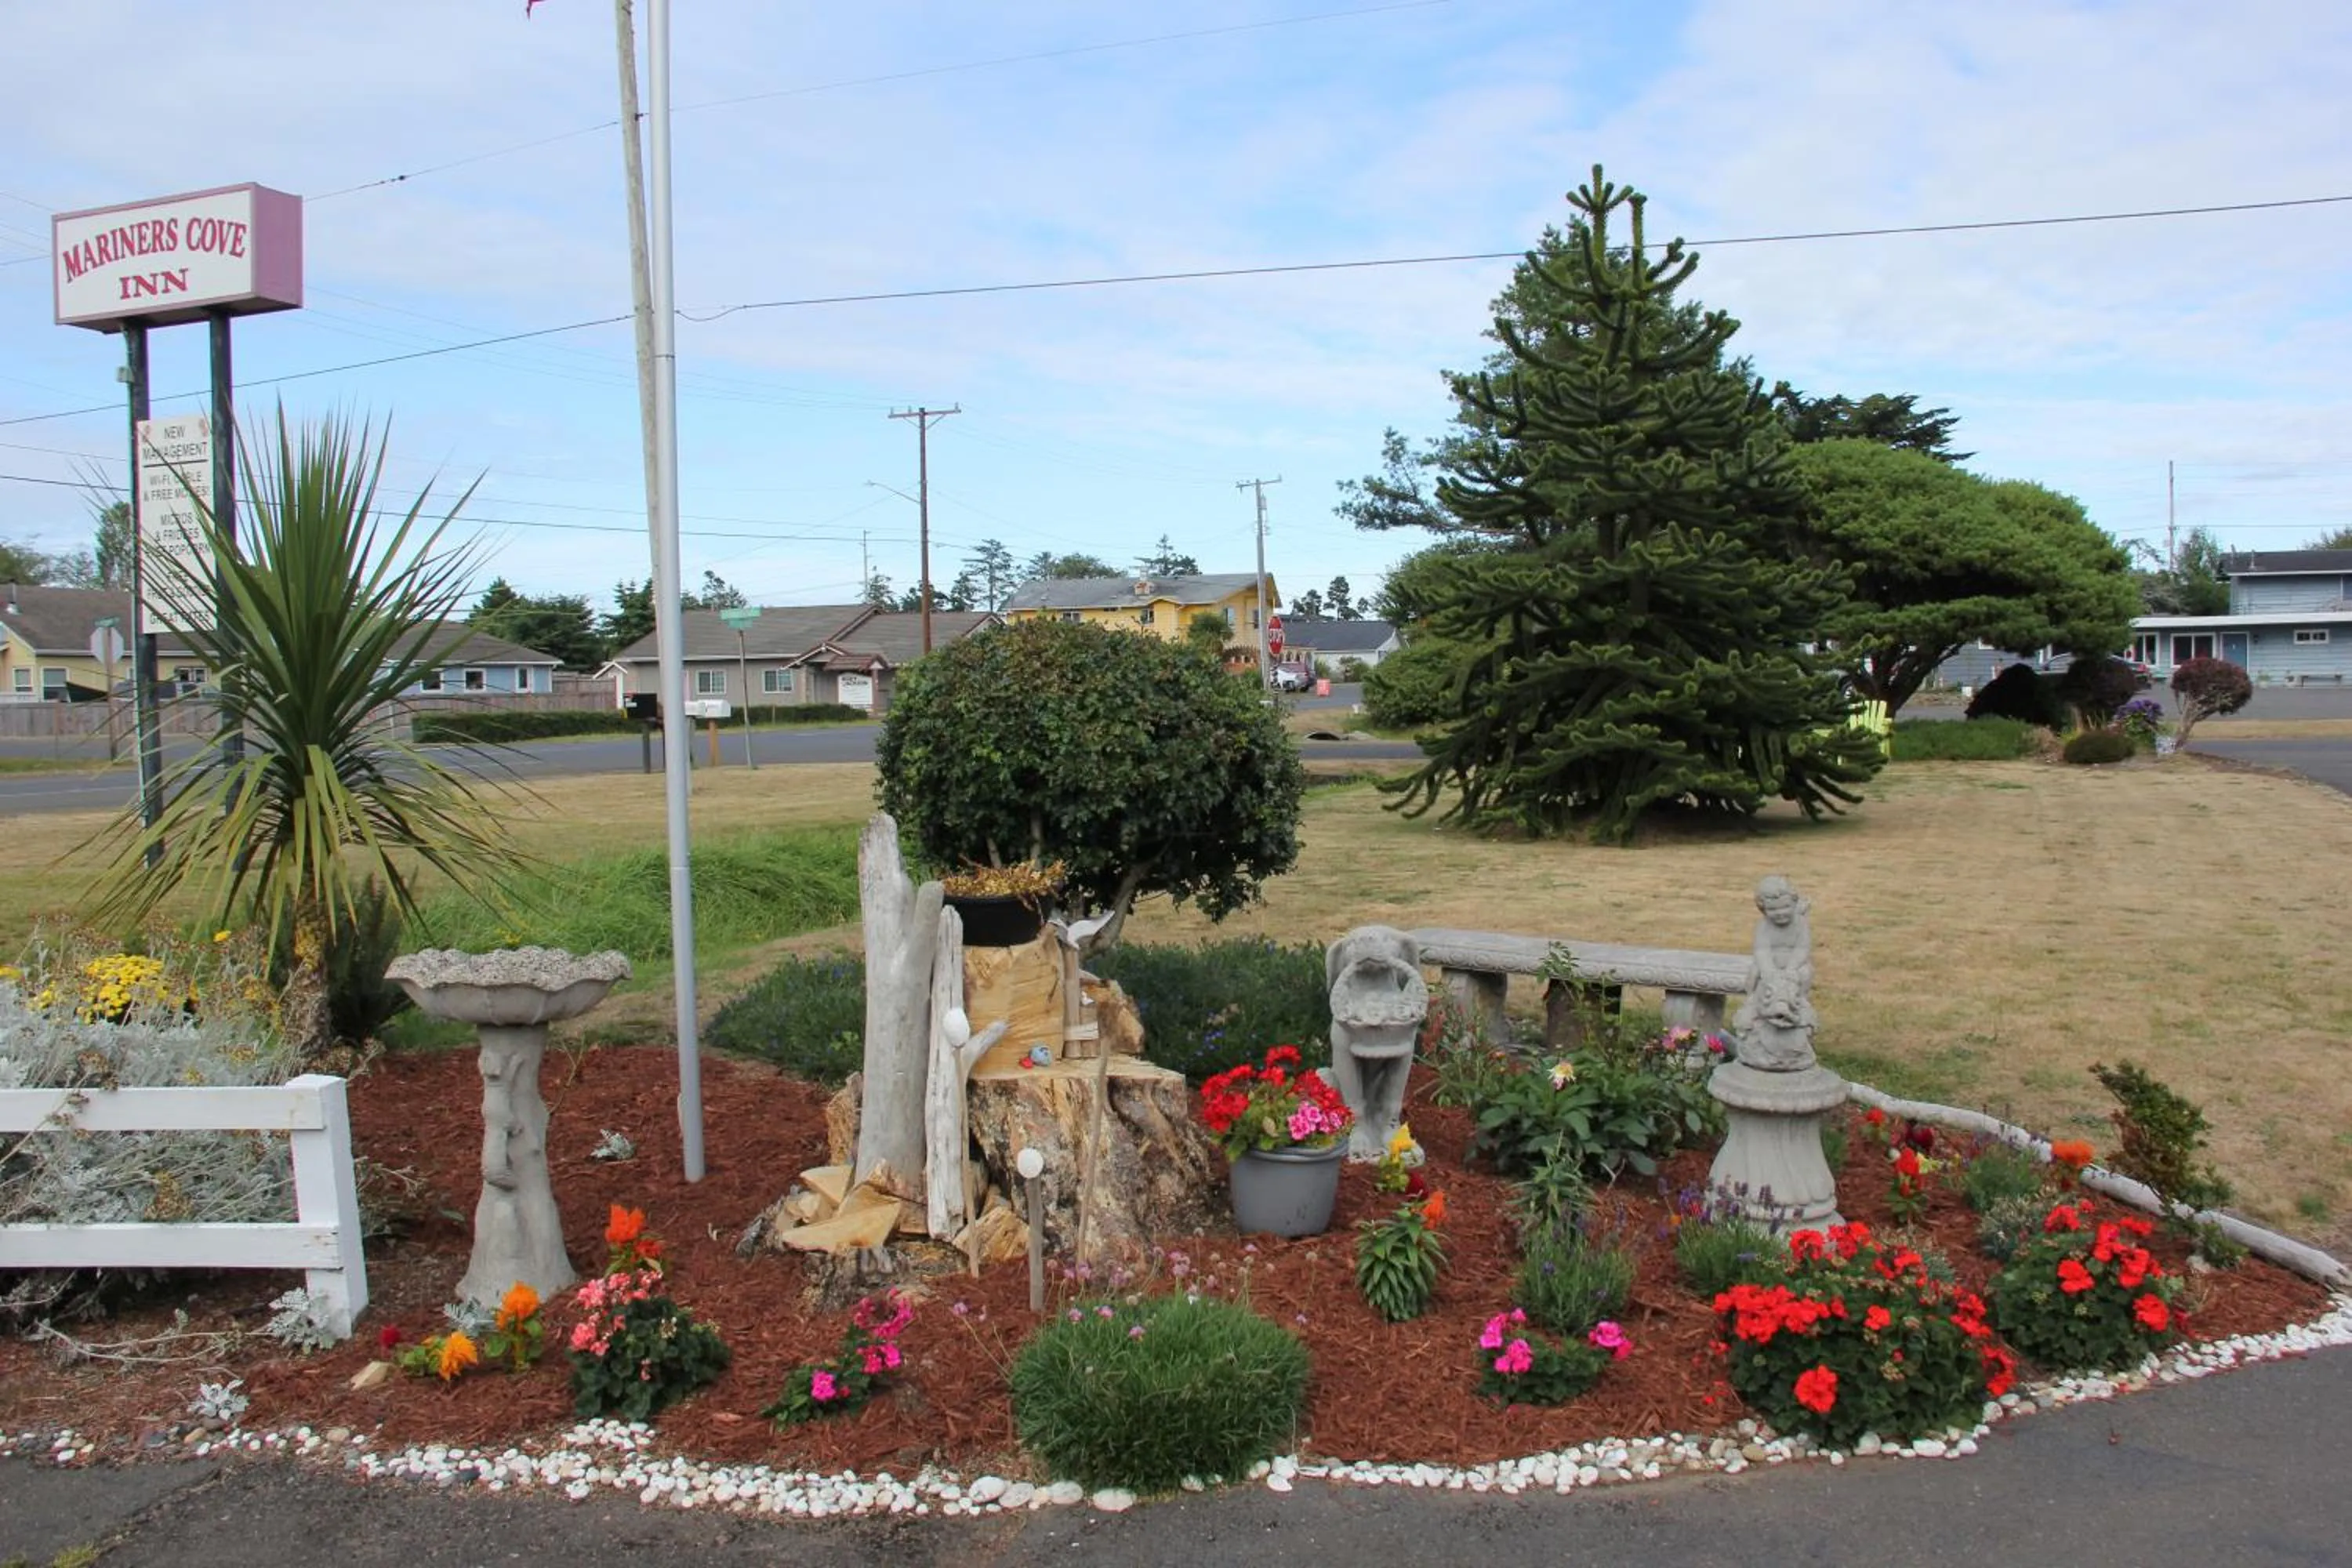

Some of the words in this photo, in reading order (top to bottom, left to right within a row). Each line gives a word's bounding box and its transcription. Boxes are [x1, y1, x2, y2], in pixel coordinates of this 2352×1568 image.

[63, 217, 179, 283] MARINERS
[187, 217, 248, 260] COVE
[119, 268, 189, 300] INN
[164, 425, 186, 440] NEW
[151, 486, 173, 501] FREE
